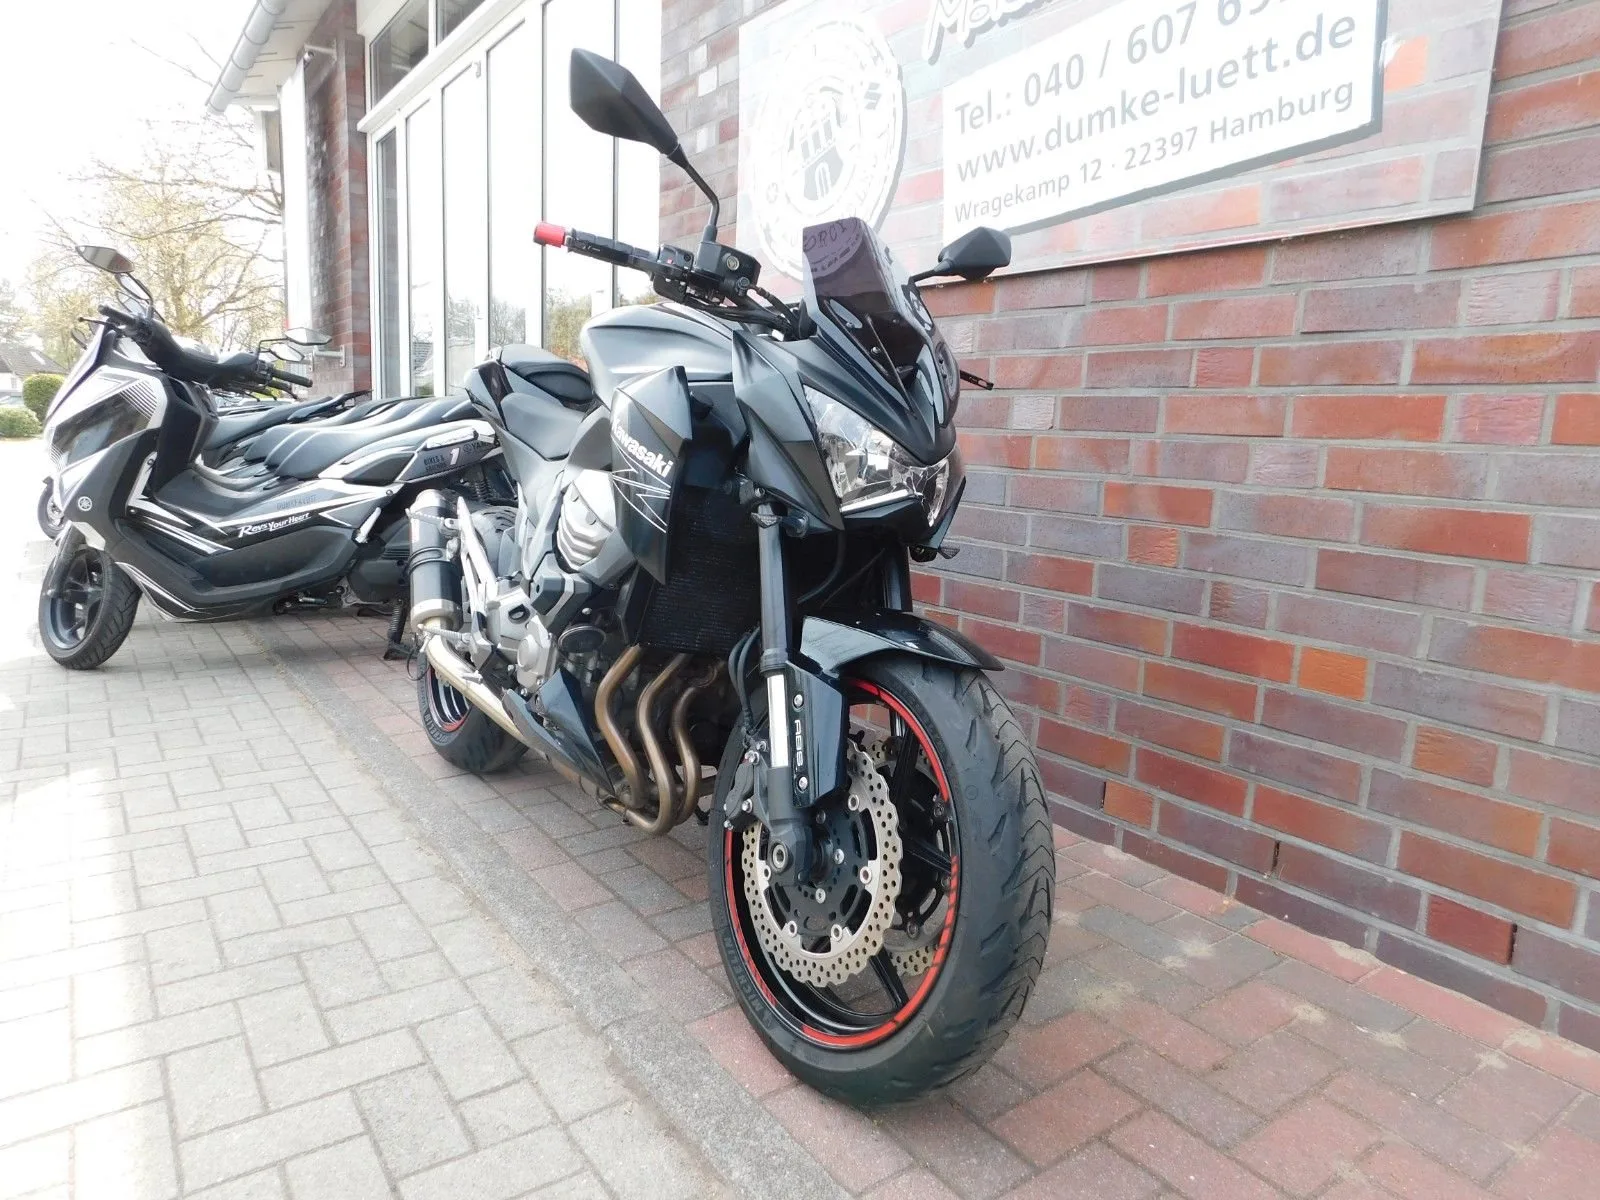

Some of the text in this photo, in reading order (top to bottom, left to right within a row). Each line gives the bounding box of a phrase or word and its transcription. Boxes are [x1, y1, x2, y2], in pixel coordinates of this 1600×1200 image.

[954, 88, 1011, 135] Tel.:
[1023, 53, 1085, 107] 040
[1098, 39, 1112, 79] /
[1126, 0, 1197, 65] 607
[957, 12, 1356, 183] www.dumke-luett.de
[954, 81, 1353, 223] Wragekamp 12 22397 Hamburg
[794, 719, 804, 767] ABS
